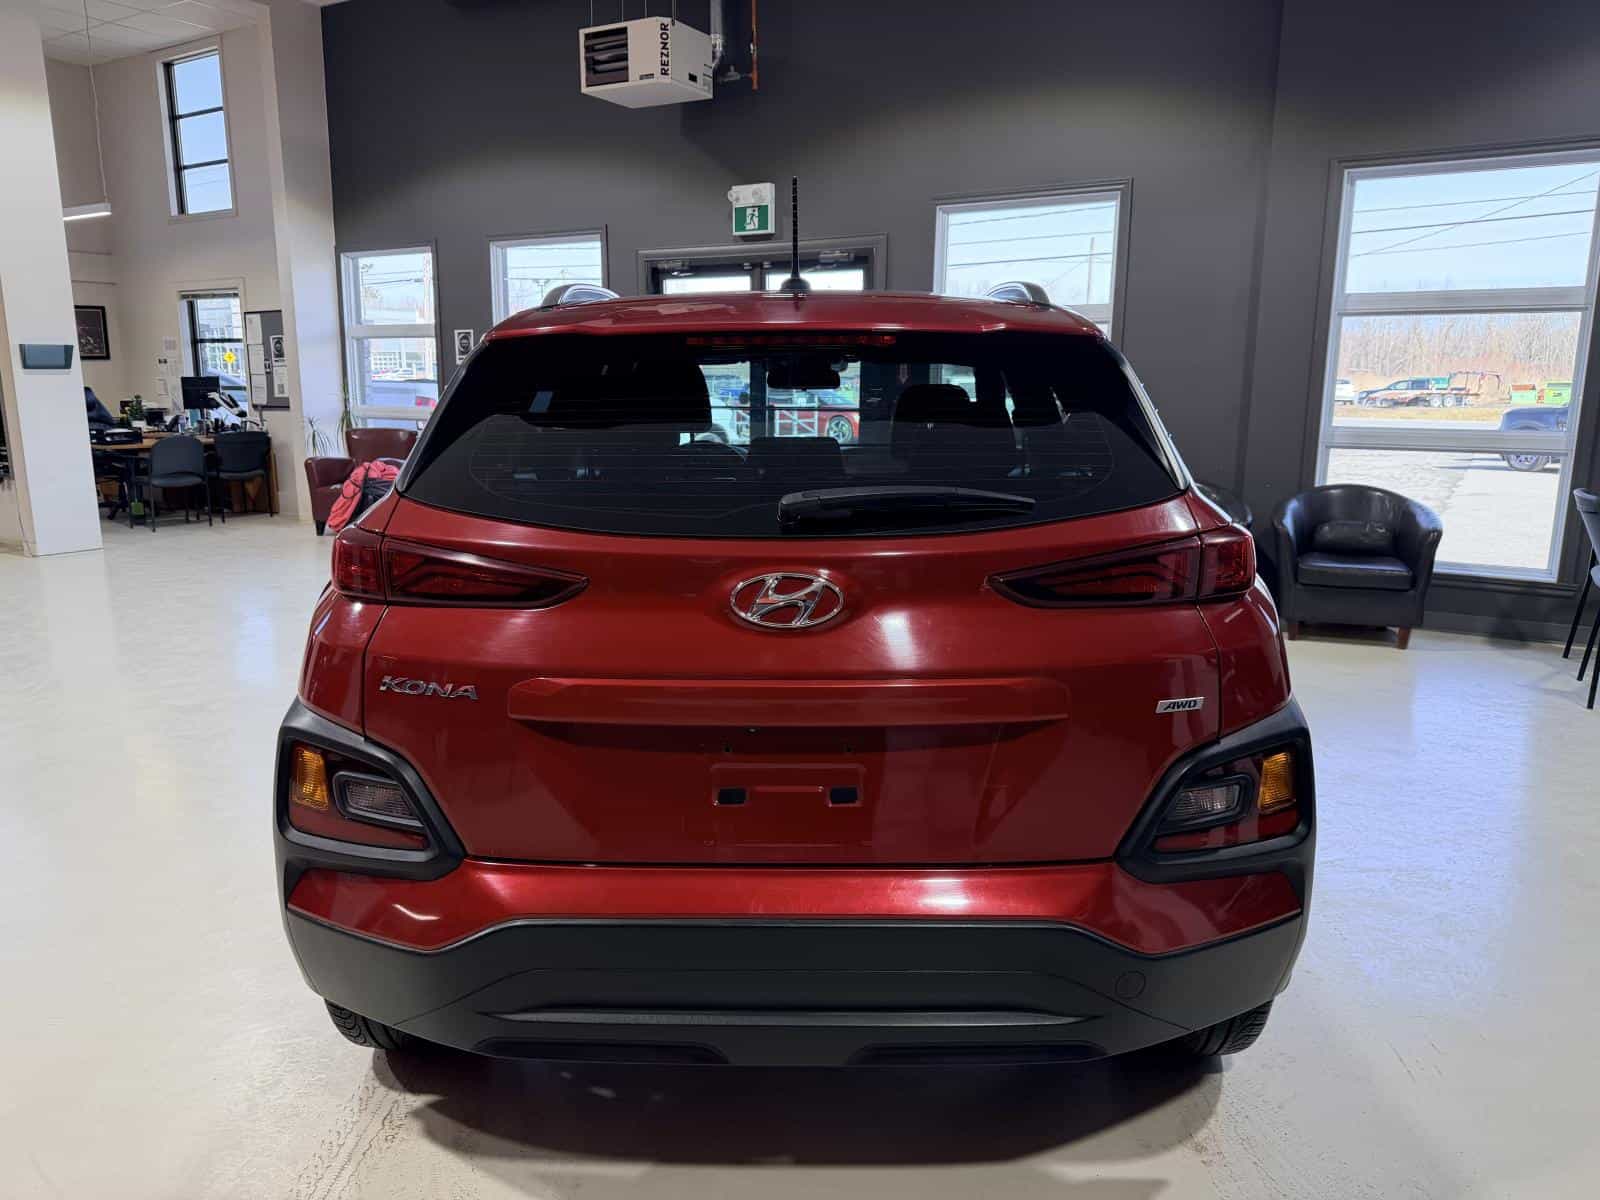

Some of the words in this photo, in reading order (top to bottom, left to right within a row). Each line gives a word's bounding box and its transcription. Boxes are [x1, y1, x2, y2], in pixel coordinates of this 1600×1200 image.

[660, 22, 670, 76] REZNOR
[379, 675, 479, 700] KONA
[1163, 699, 1198, 711] AWD
